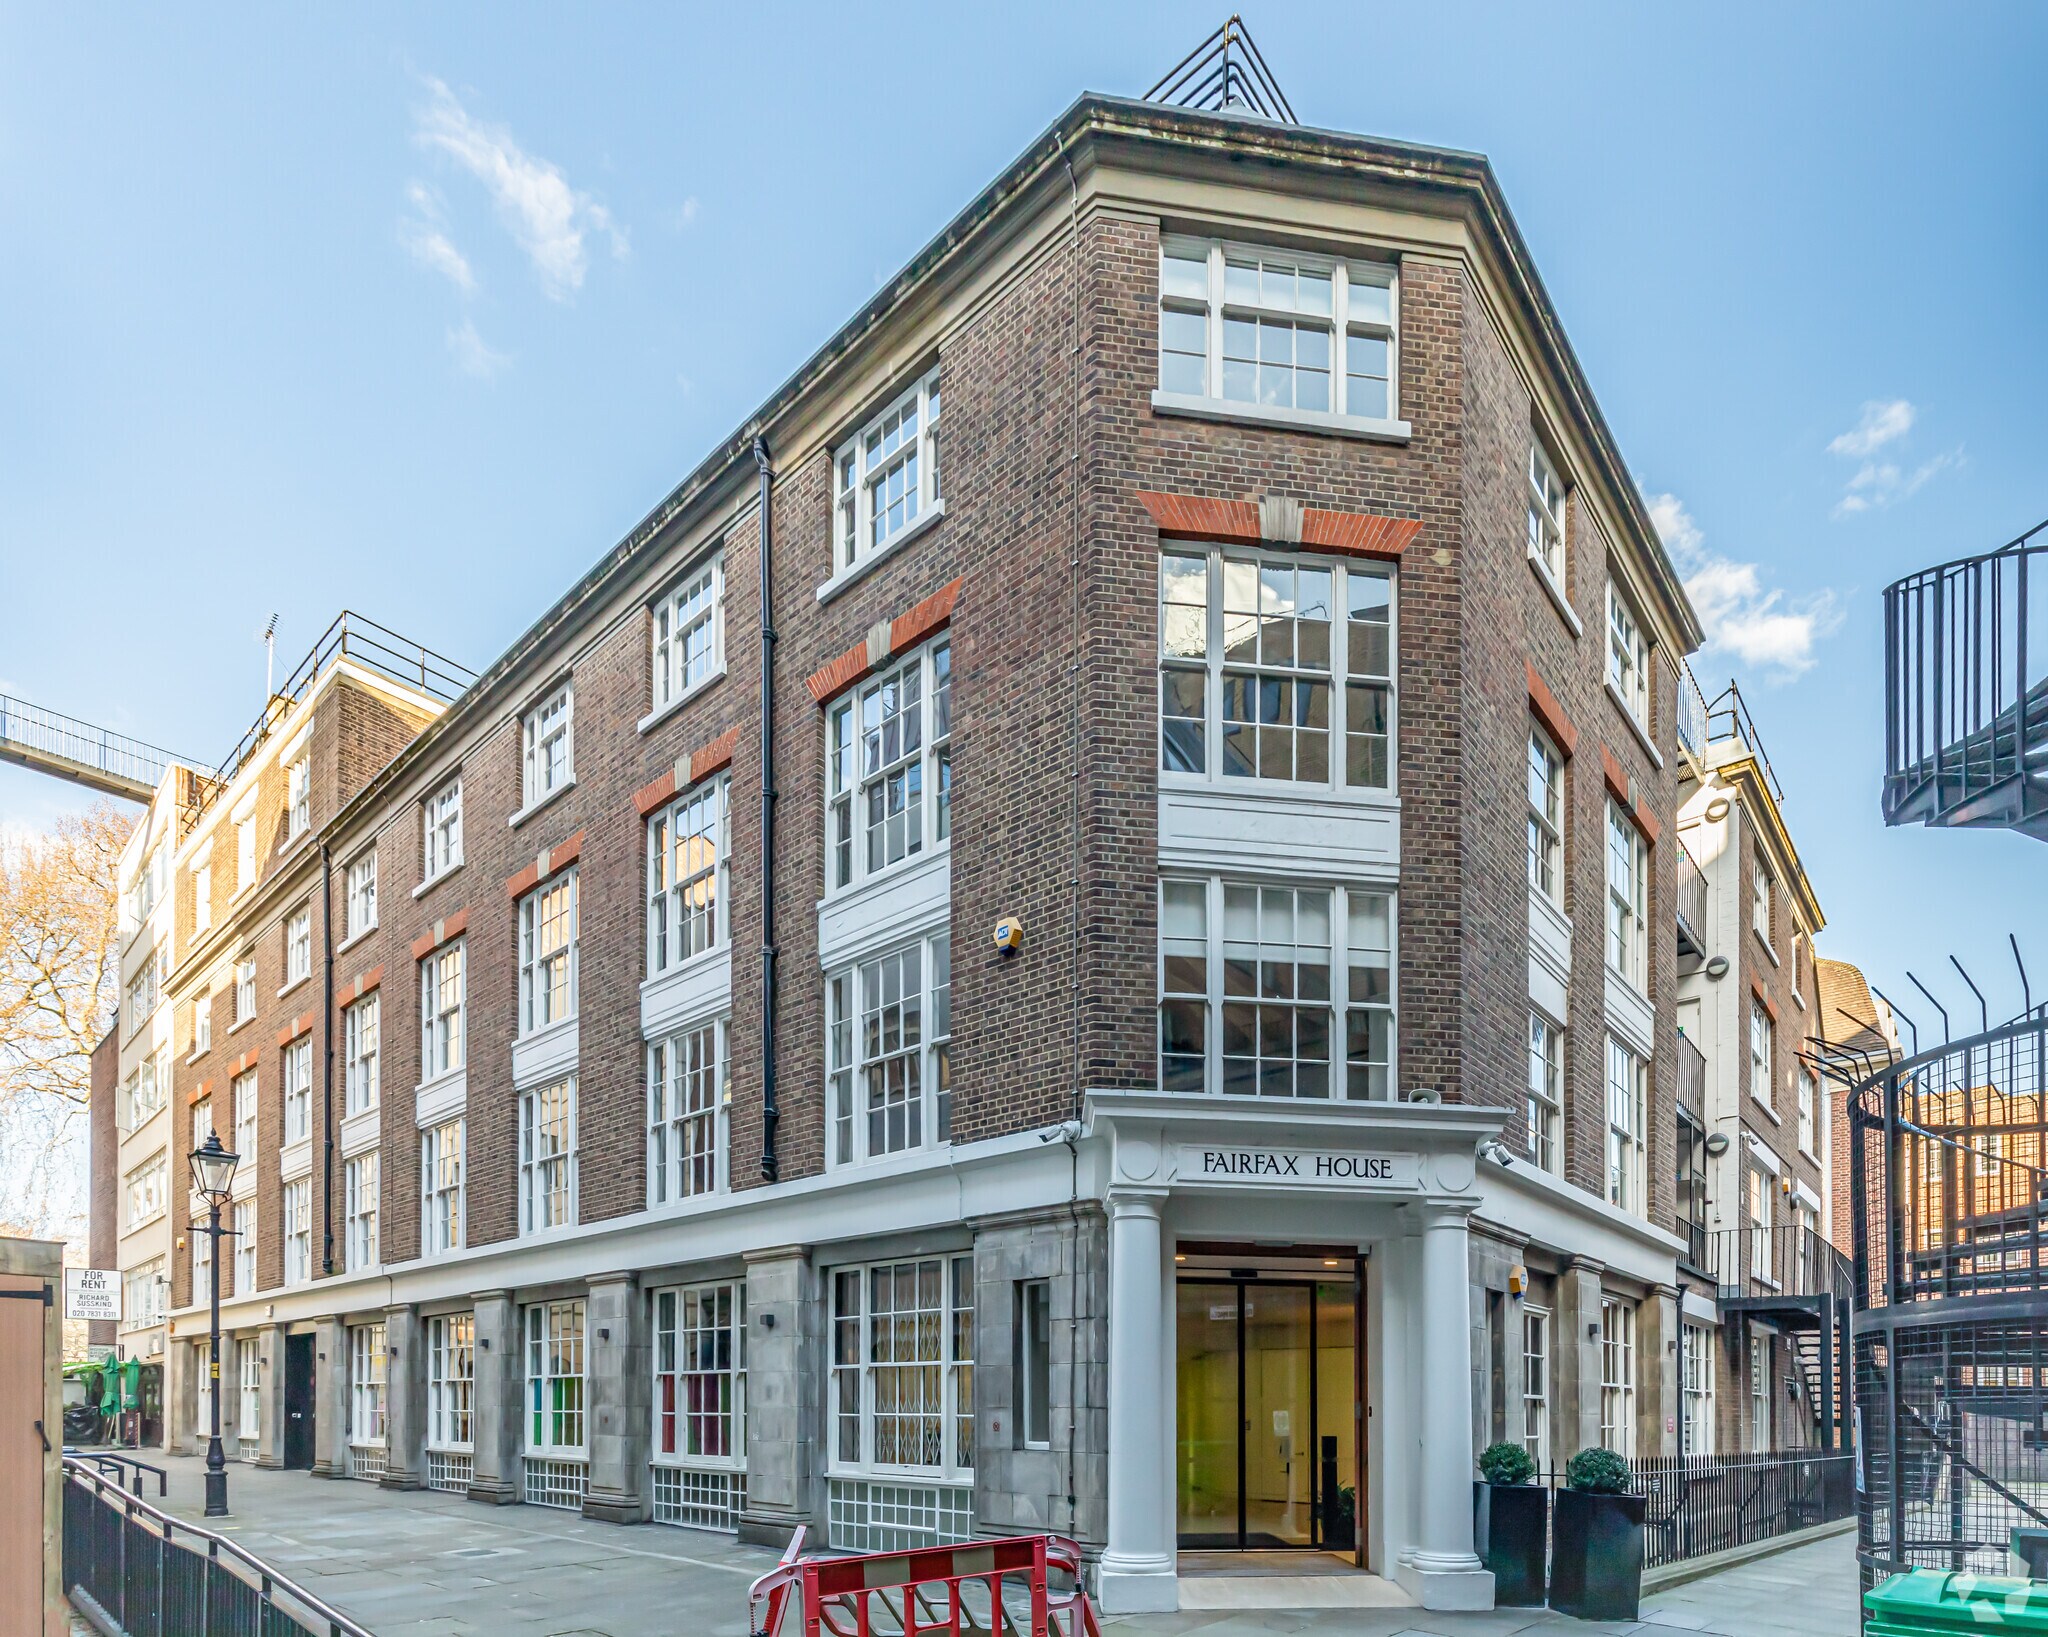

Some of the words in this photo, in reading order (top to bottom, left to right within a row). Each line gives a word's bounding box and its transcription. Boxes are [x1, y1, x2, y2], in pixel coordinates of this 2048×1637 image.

[1203, 1152, 1300, 1176] FAIRFAX
[1315, 1156, 1394, 1179] HOUSE
[84, 1270, 103, 1280] FOR
[81, 1280, 107, 1289] RENT
